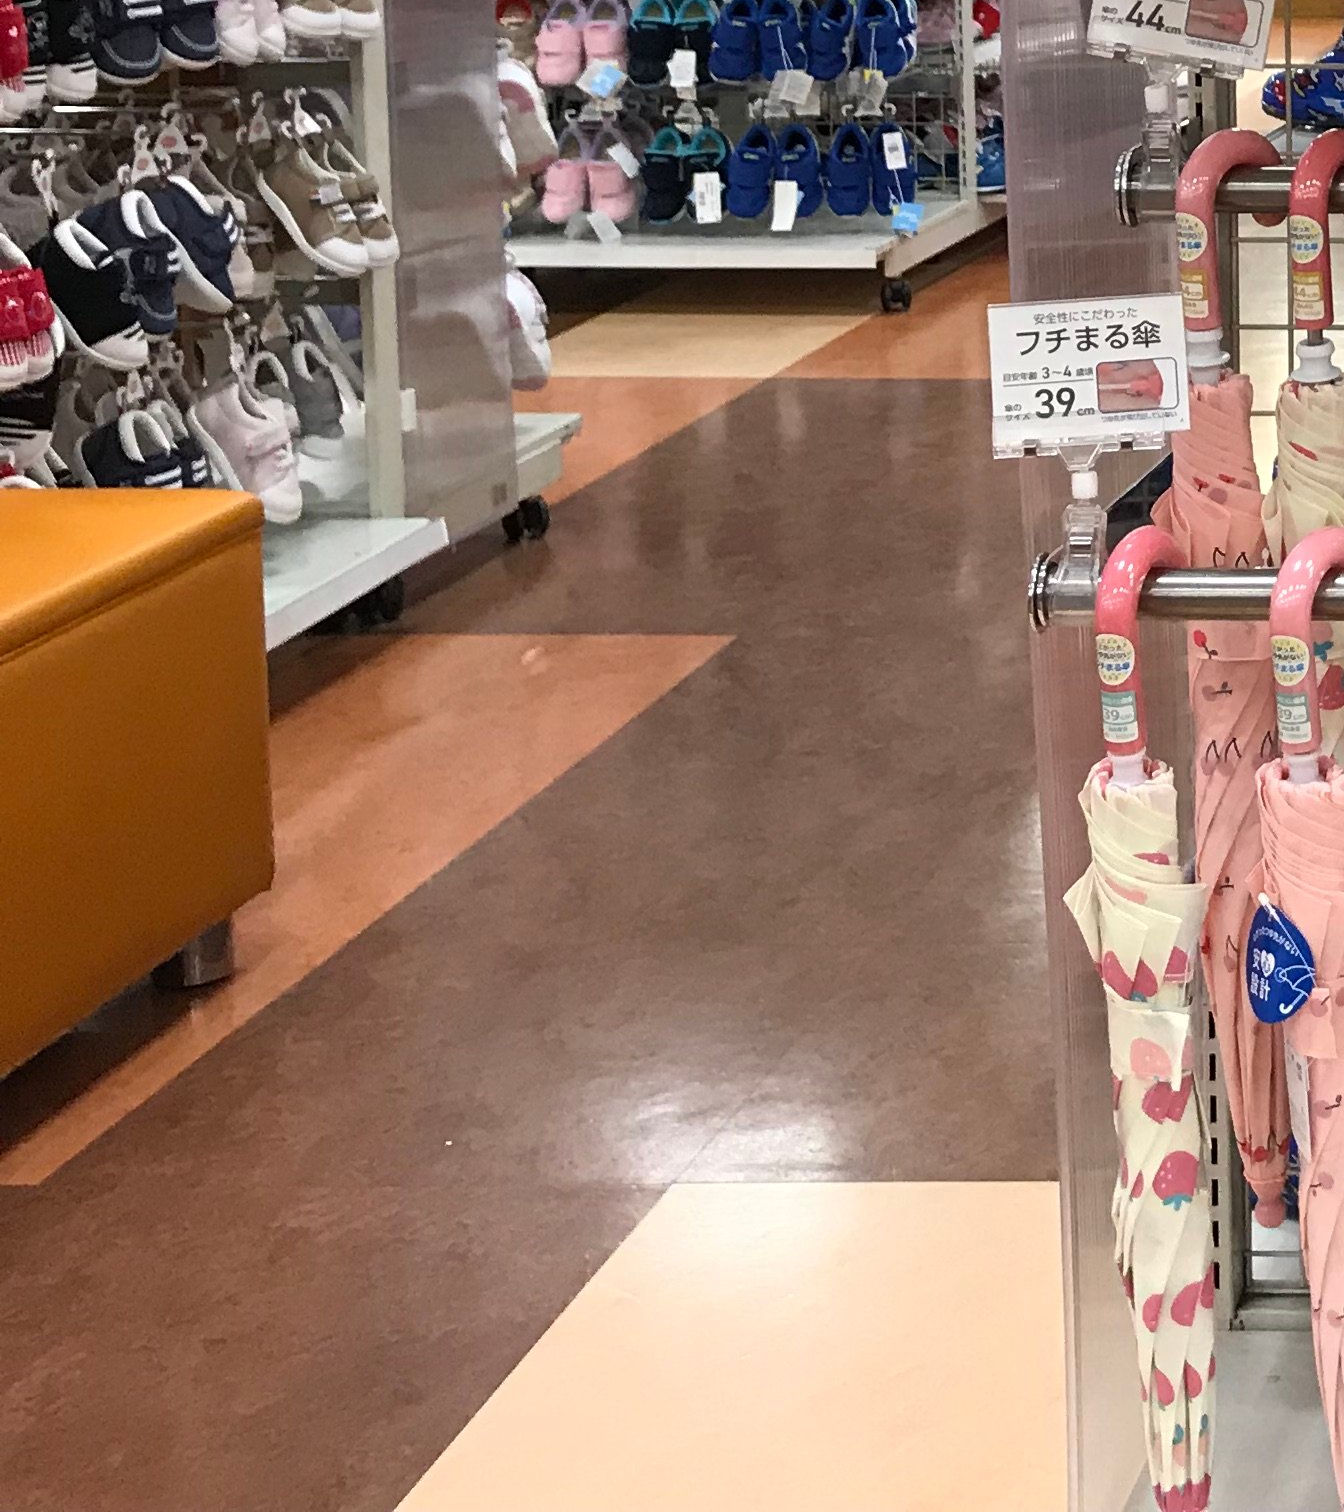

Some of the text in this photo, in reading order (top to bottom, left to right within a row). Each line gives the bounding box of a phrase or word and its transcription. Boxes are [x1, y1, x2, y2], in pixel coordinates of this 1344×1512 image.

[1033, 306, 1138, 325] 安全性にこだわった
[1016, 320, 1162, 356] フチまる傘
[1034, 387, 1095, 419] 39cm
